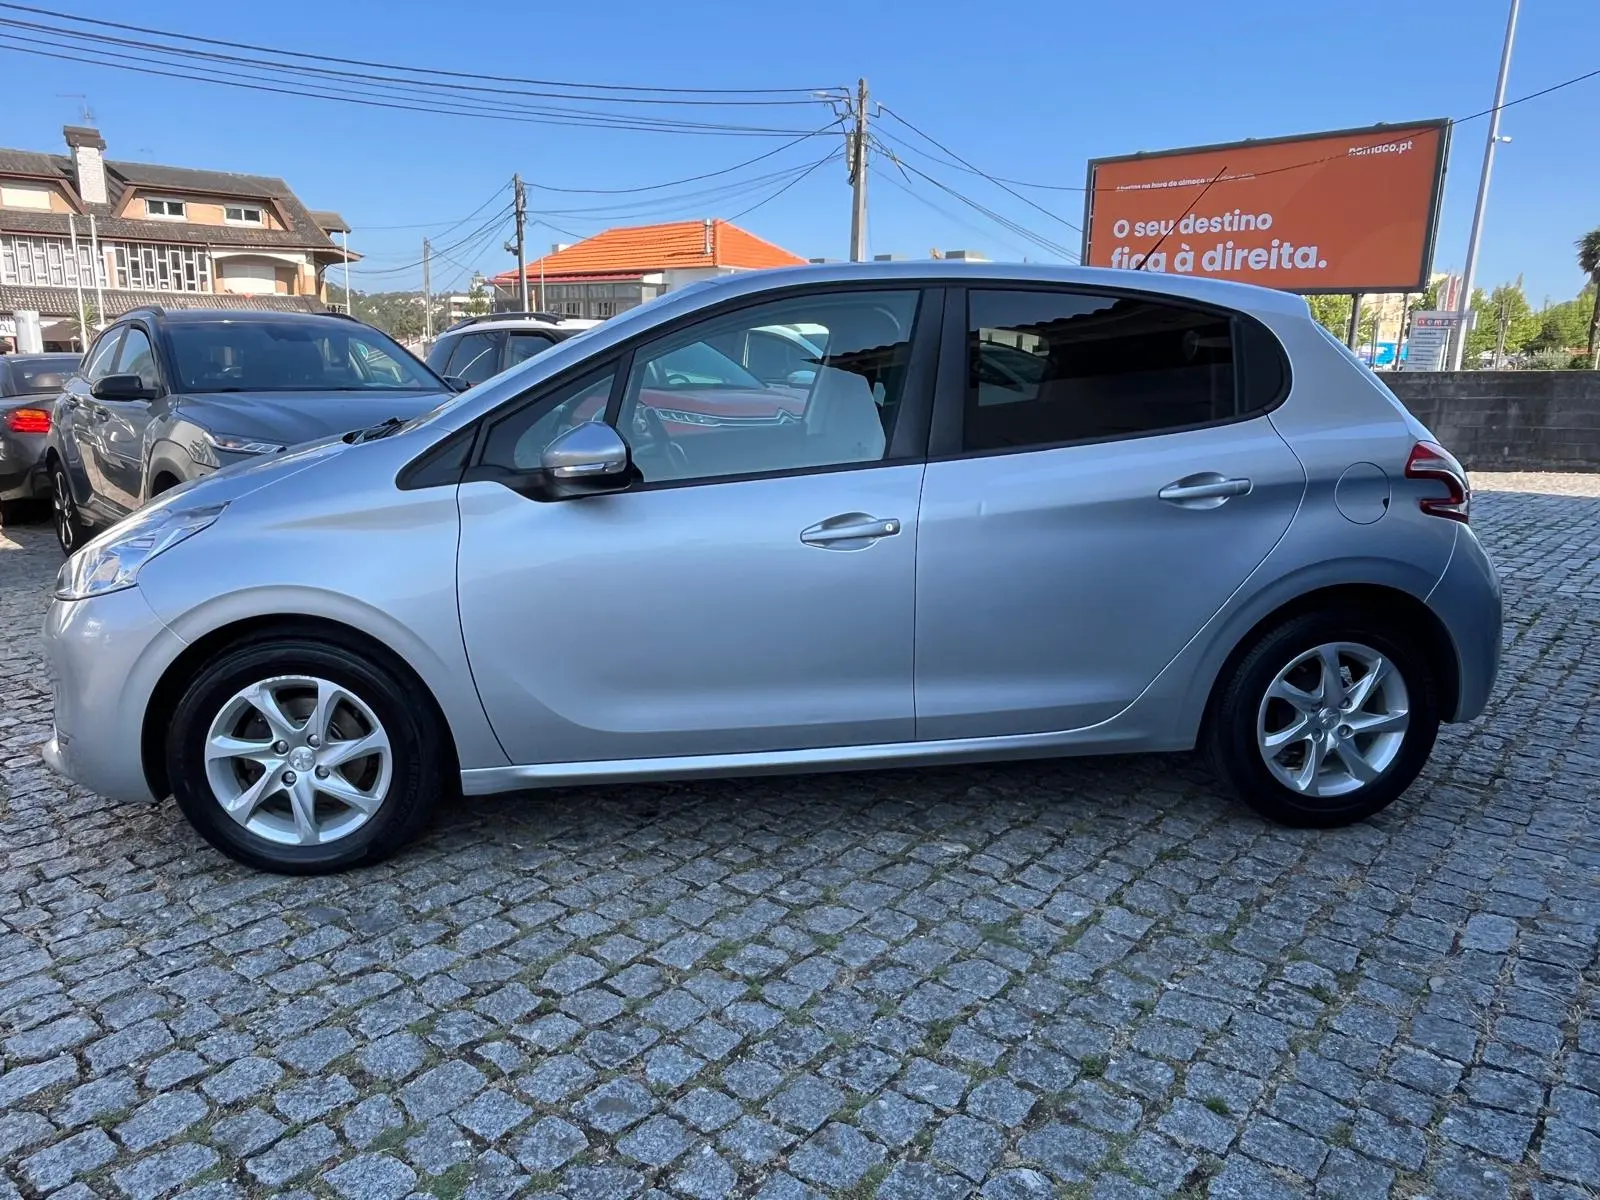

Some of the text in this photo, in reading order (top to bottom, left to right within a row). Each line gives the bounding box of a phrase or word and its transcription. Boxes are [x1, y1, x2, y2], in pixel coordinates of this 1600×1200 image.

[1168, 179, 1178, 187] de
[1113, 208, 1273, 238] O seu destino
[1111, 238, 1328, 272] fica à direita.
